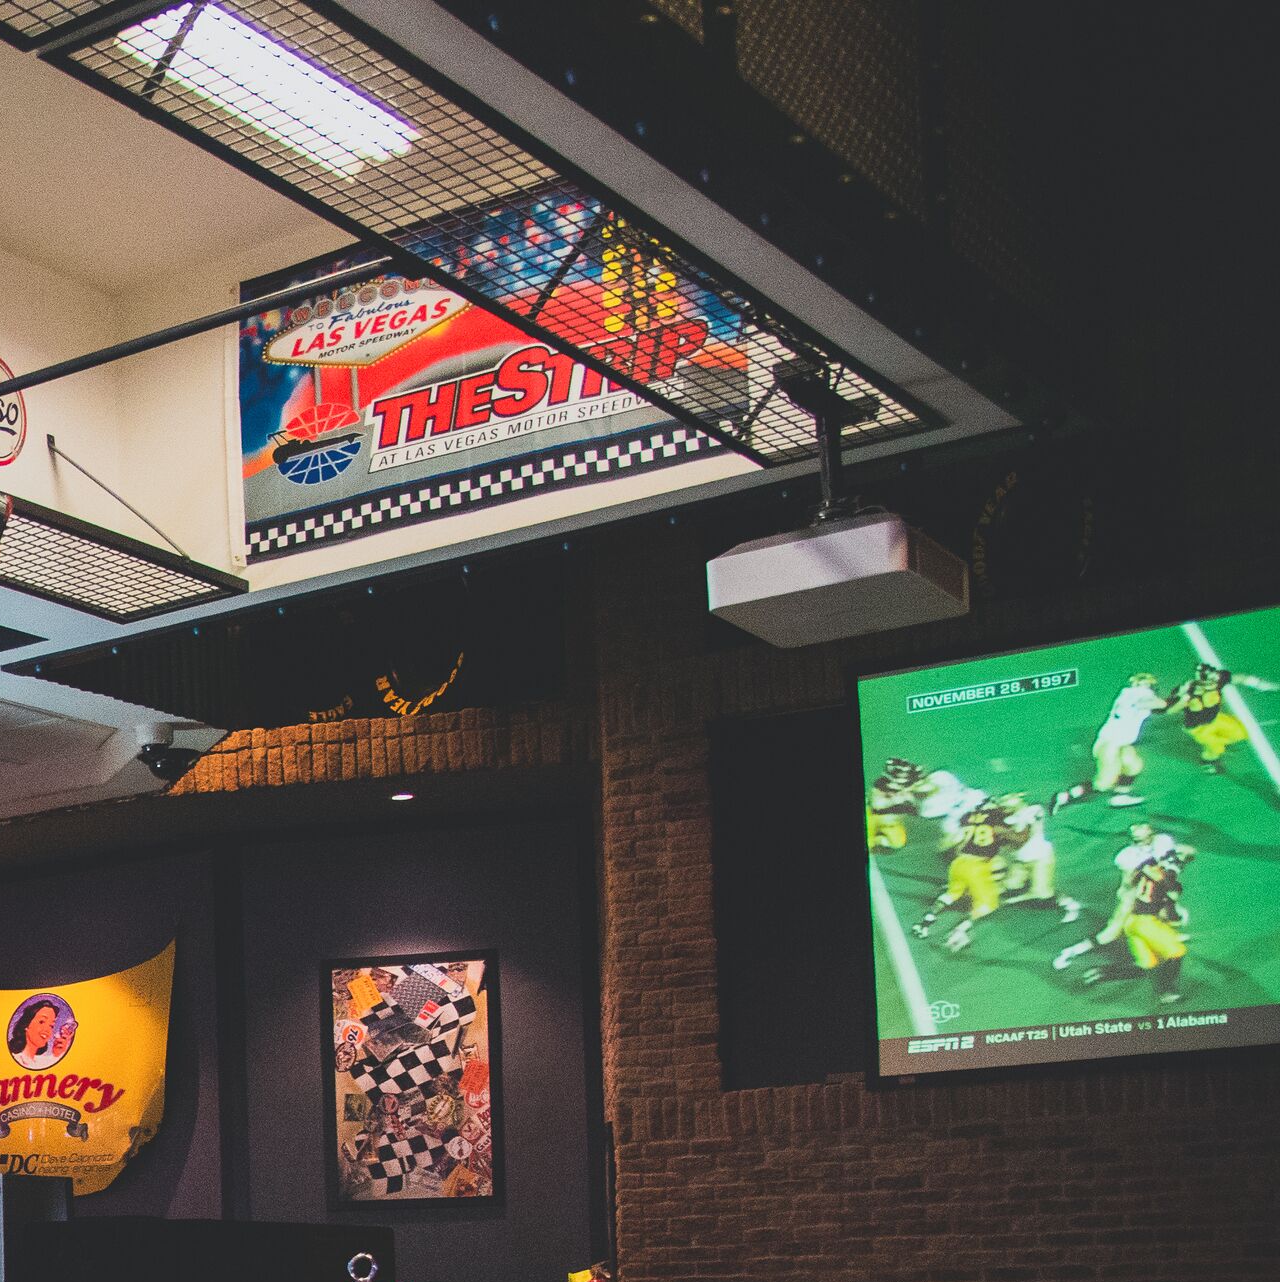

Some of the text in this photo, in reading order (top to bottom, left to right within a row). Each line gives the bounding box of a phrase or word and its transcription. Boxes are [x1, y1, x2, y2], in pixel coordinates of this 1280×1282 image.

[291, 298, 451, 358] LAS VEGAS
[308, 299, 415, 331] TO Fabulous
[318, 328, 417, 359] MOTOR SPEEDWAY
[378, 453, 399, 468] AT
[405, 444, 437, 463] LAS
[444, 428, 499, 452] VEGAS
[507, 410, 568, 437] MOTOR
[912, 673, 1072, 709] NOVEMBER 28, 1997
[347, 1027, 359, 1043] 76
[985, 1031, 1025, 1045] NCAAF
[1026, 1028, 1048, 1041] T25
[1059, 1024, 1092, 1038] Utah
[1094, 1021, 1132, 1035] State
[1137, 1021, 1152, 1030] vs
[1166, 1012, 1228, 1029] Alabama
[0, 1105, 78, 1123] CASINO HOTEL
[8, 1154, 39, 1175] DC
